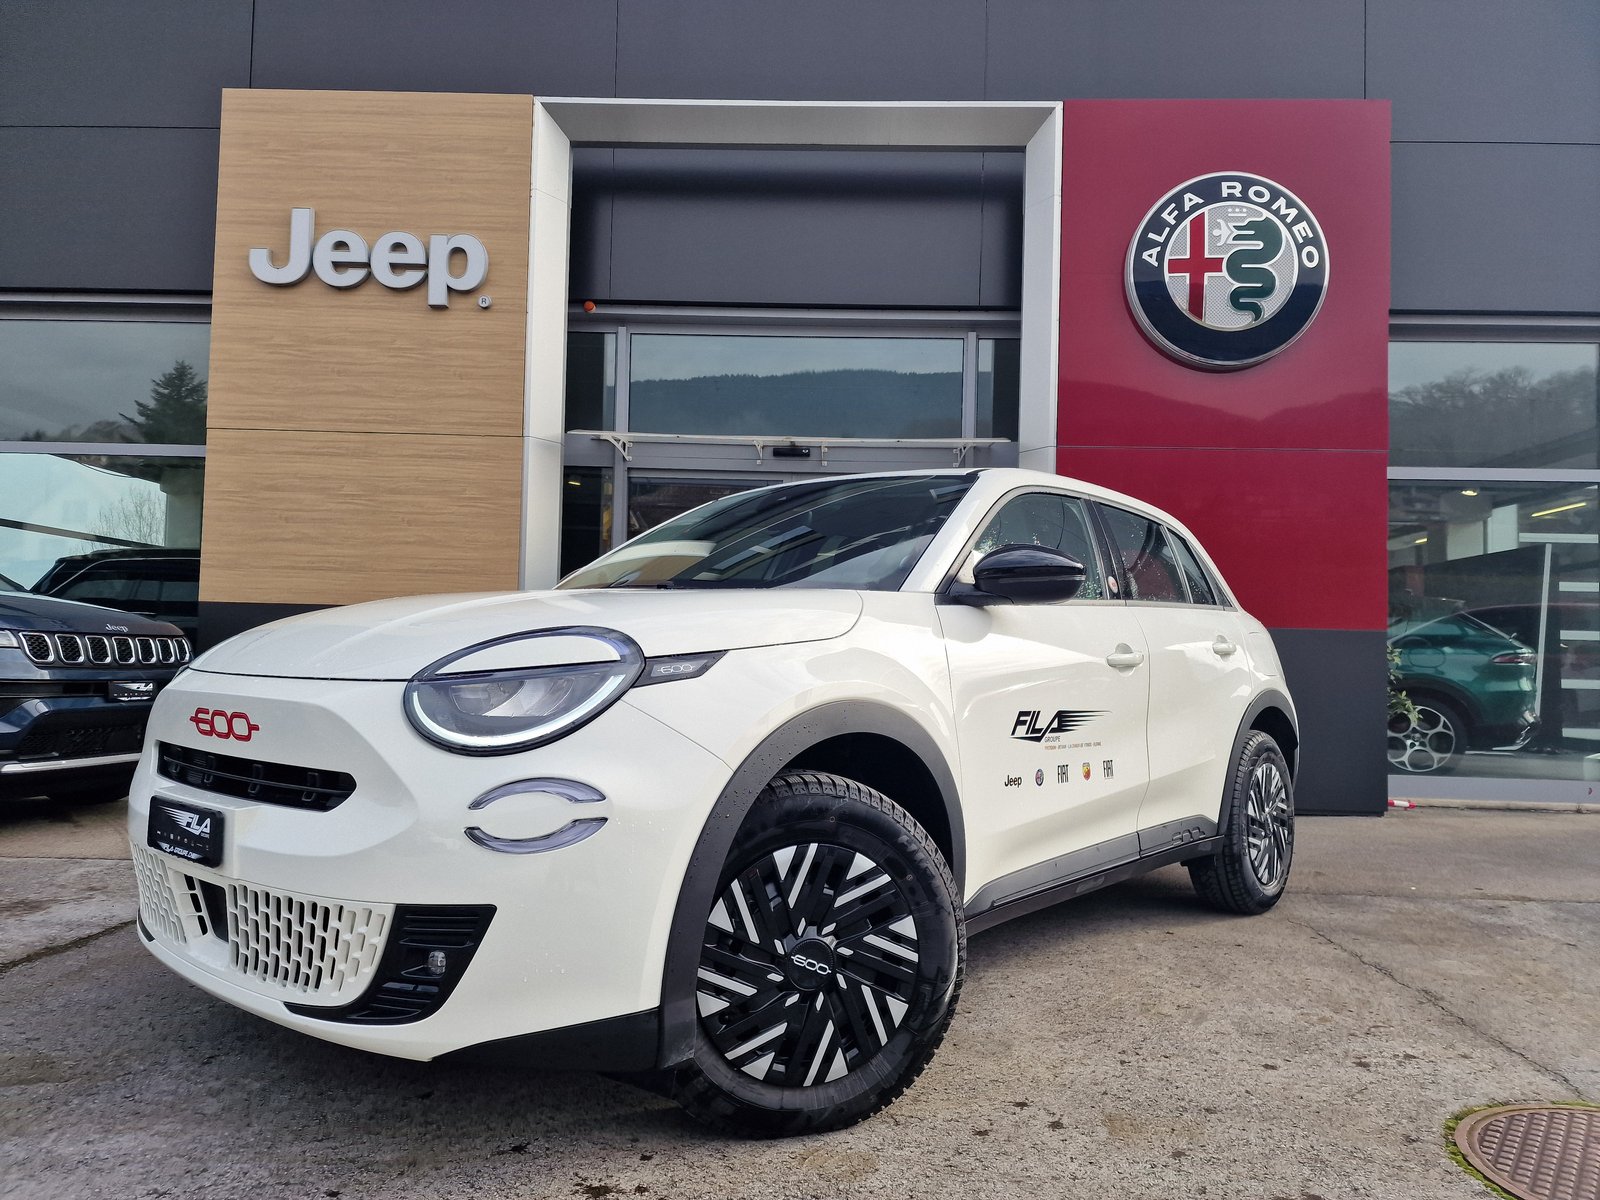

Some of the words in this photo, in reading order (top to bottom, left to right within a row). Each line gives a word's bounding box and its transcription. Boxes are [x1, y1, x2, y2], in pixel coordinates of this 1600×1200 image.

[1142, 192, 1205, 267] ALFA
[1220, 181, 1320, 268] ROMEO
[248, 206, 489, 309] Jeep
[105, 623, 129, 633] Jeep
[657, 664, 695, 674] 600
[190, 708, 260, 742] 600
[1009, 709, 1079, 743] FILA
[1004, 774, 1022, 788] Jeep
[1057, 764, 1069, 784] FIAT
[1102, 759, 1114, 778] FIAT
[177, 810, 211, 836] FILA
[790, 954, 832, 975] 600
